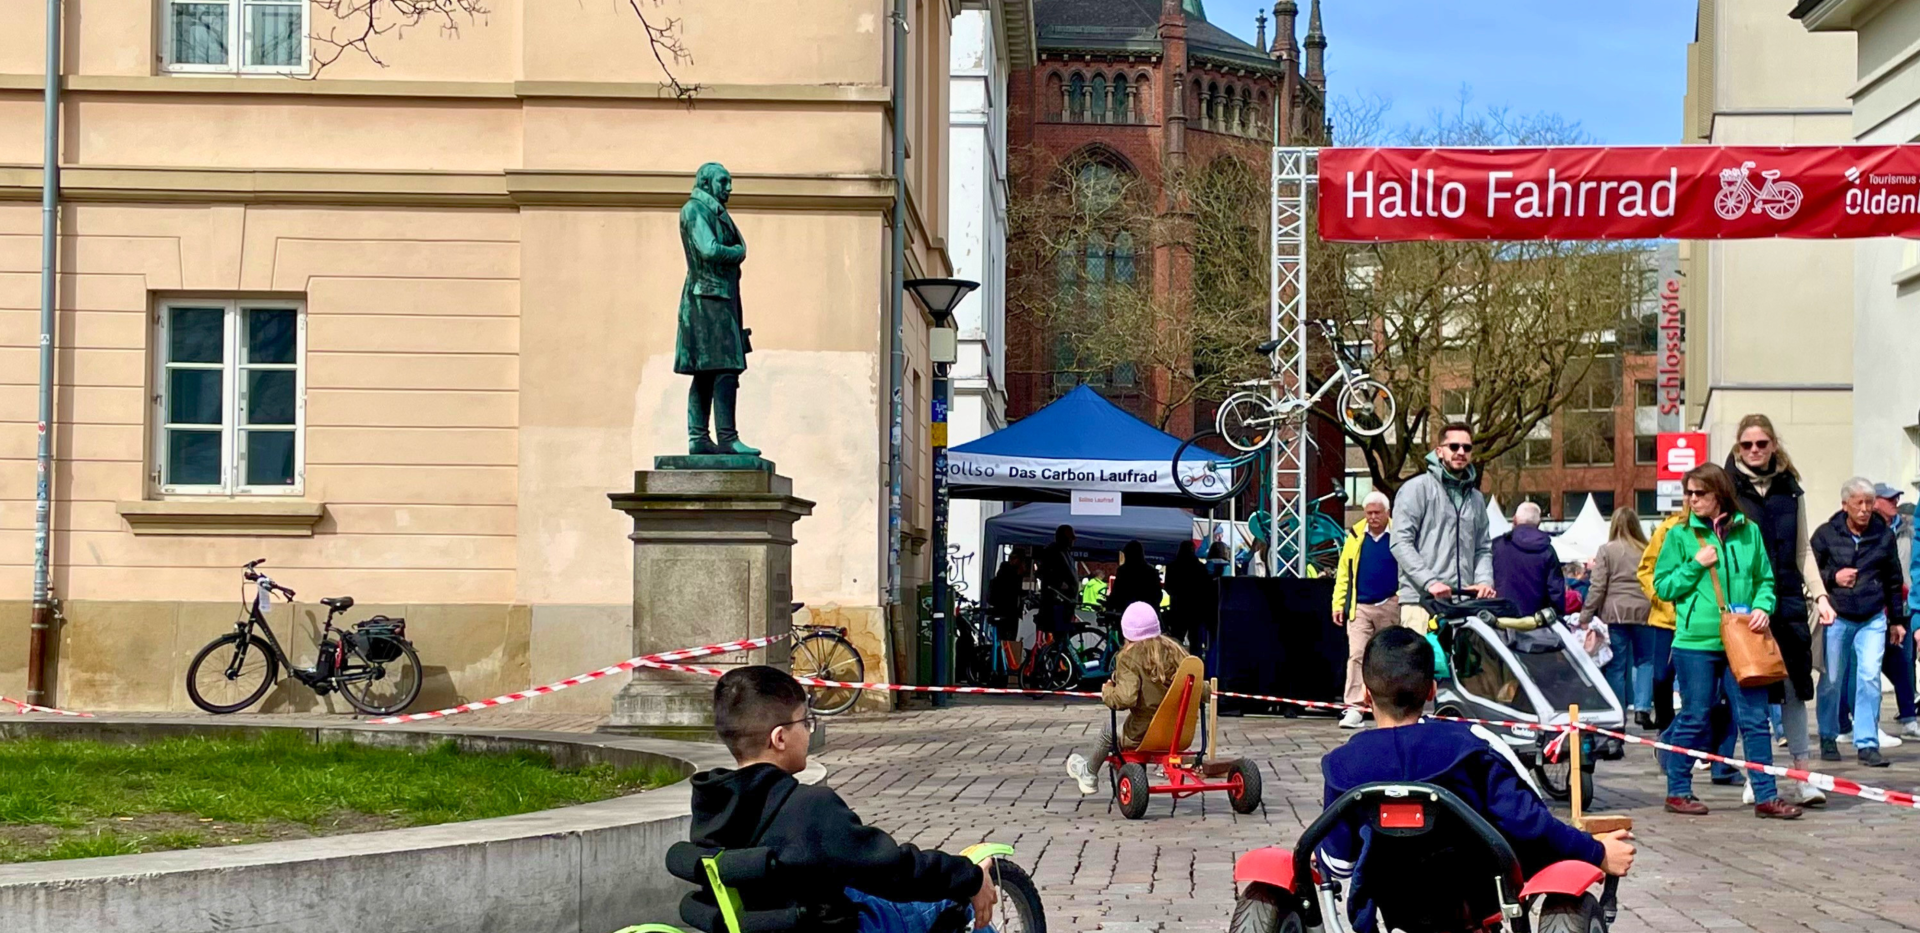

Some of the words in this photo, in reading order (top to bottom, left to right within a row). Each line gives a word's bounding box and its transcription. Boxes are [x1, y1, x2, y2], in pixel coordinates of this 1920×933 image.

[1869, 172, 1917, 185] Tourismus
[1346, 170, 1467, 220] Hallo
[1487, 167, 1678, 218] Fahrrad
[1845, 187, 1920, 215] Olden
[1660, 280, 1681, 415] Schlosshöfe
[1008, 466, 1037, 479] Das
[1041, 468, 1095, 482] Carbon
[1099, 469, 1158, 483] Laufrad
